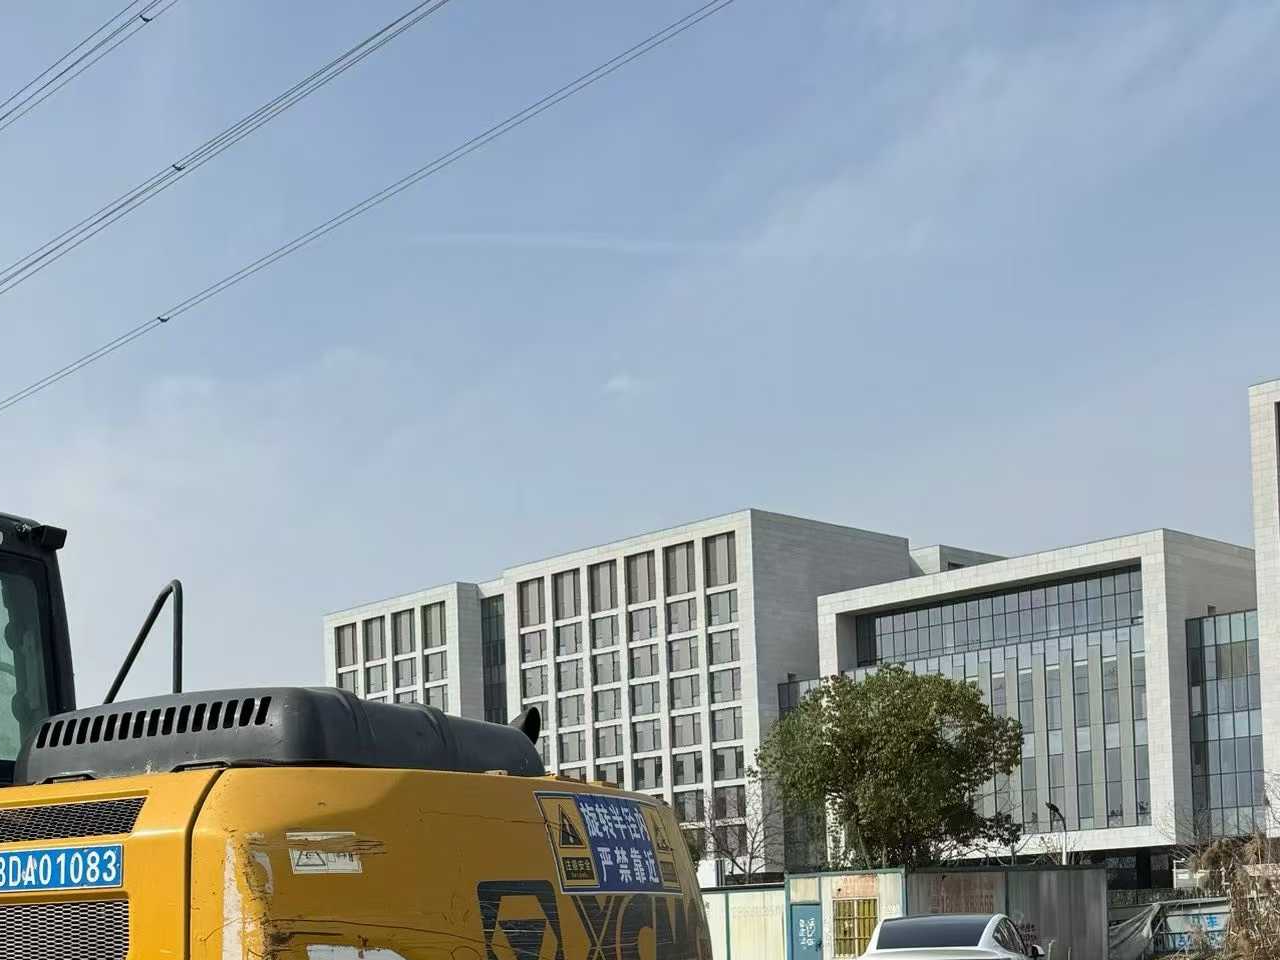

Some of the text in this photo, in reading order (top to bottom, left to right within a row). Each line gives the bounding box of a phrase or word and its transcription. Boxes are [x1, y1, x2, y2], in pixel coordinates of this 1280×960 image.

[579, 802, 651, 841] 旋转半径内
[596, 846, 660, 884] 严禁靠近
